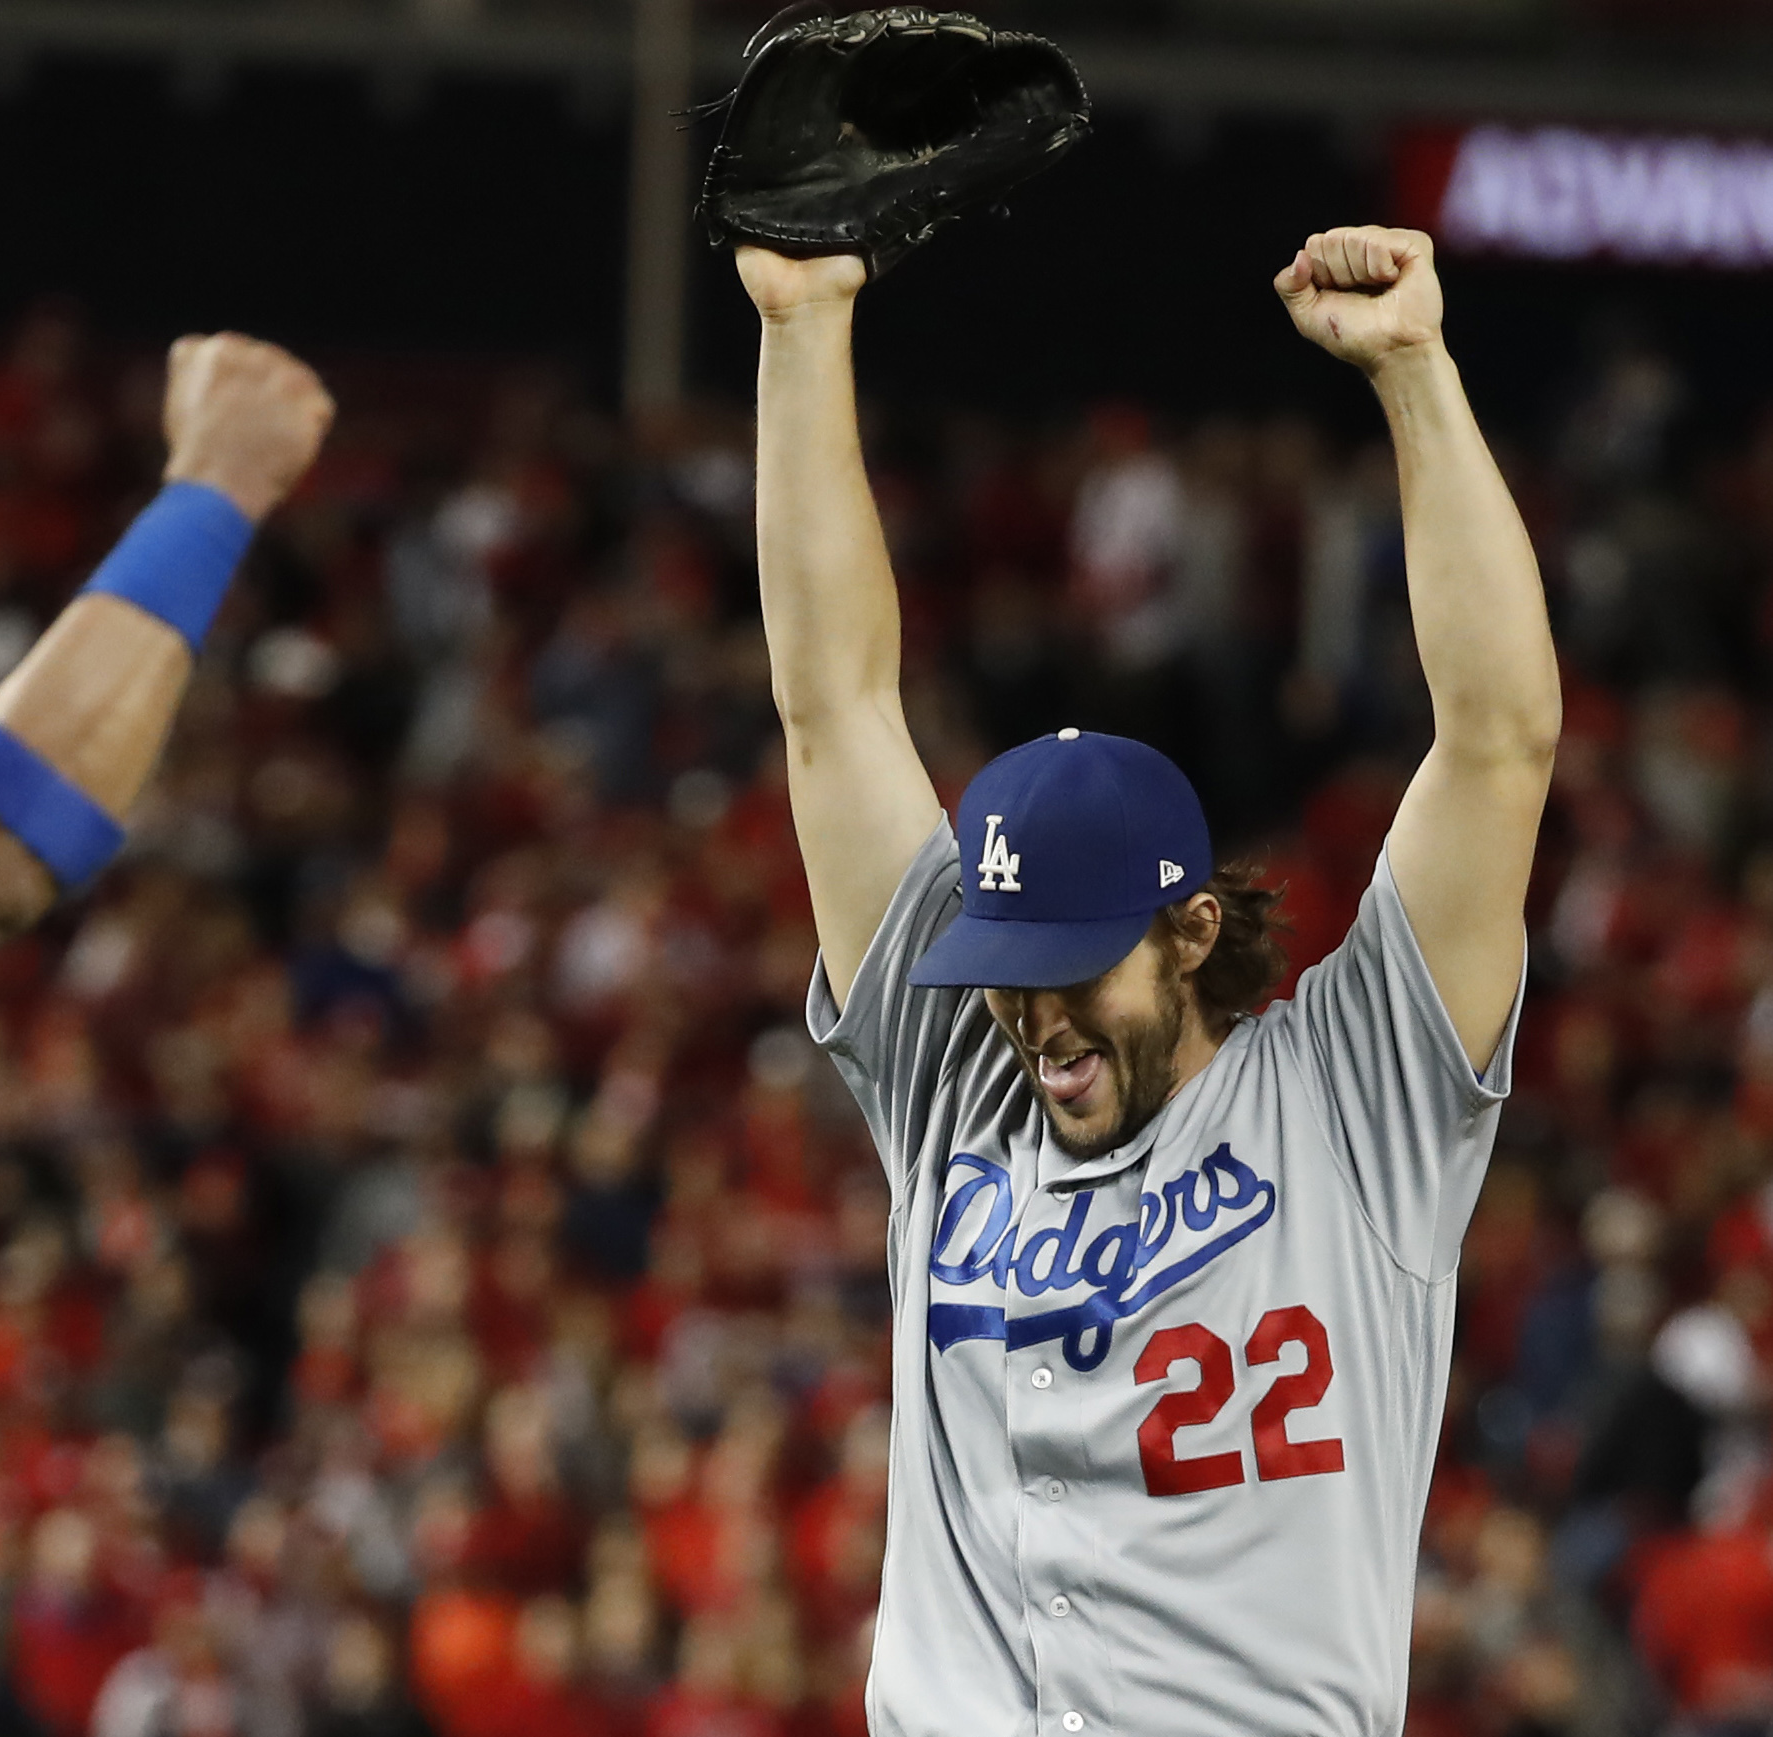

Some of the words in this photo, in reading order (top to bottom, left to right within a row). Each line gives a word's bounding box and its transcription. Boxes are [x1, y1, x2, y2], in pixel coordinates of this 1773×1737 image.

[977, 813, 1022, 893] LA
[928, 1141, 1277, 1373] Dodgers
[1133, 1304, 1346, 1498] 22
